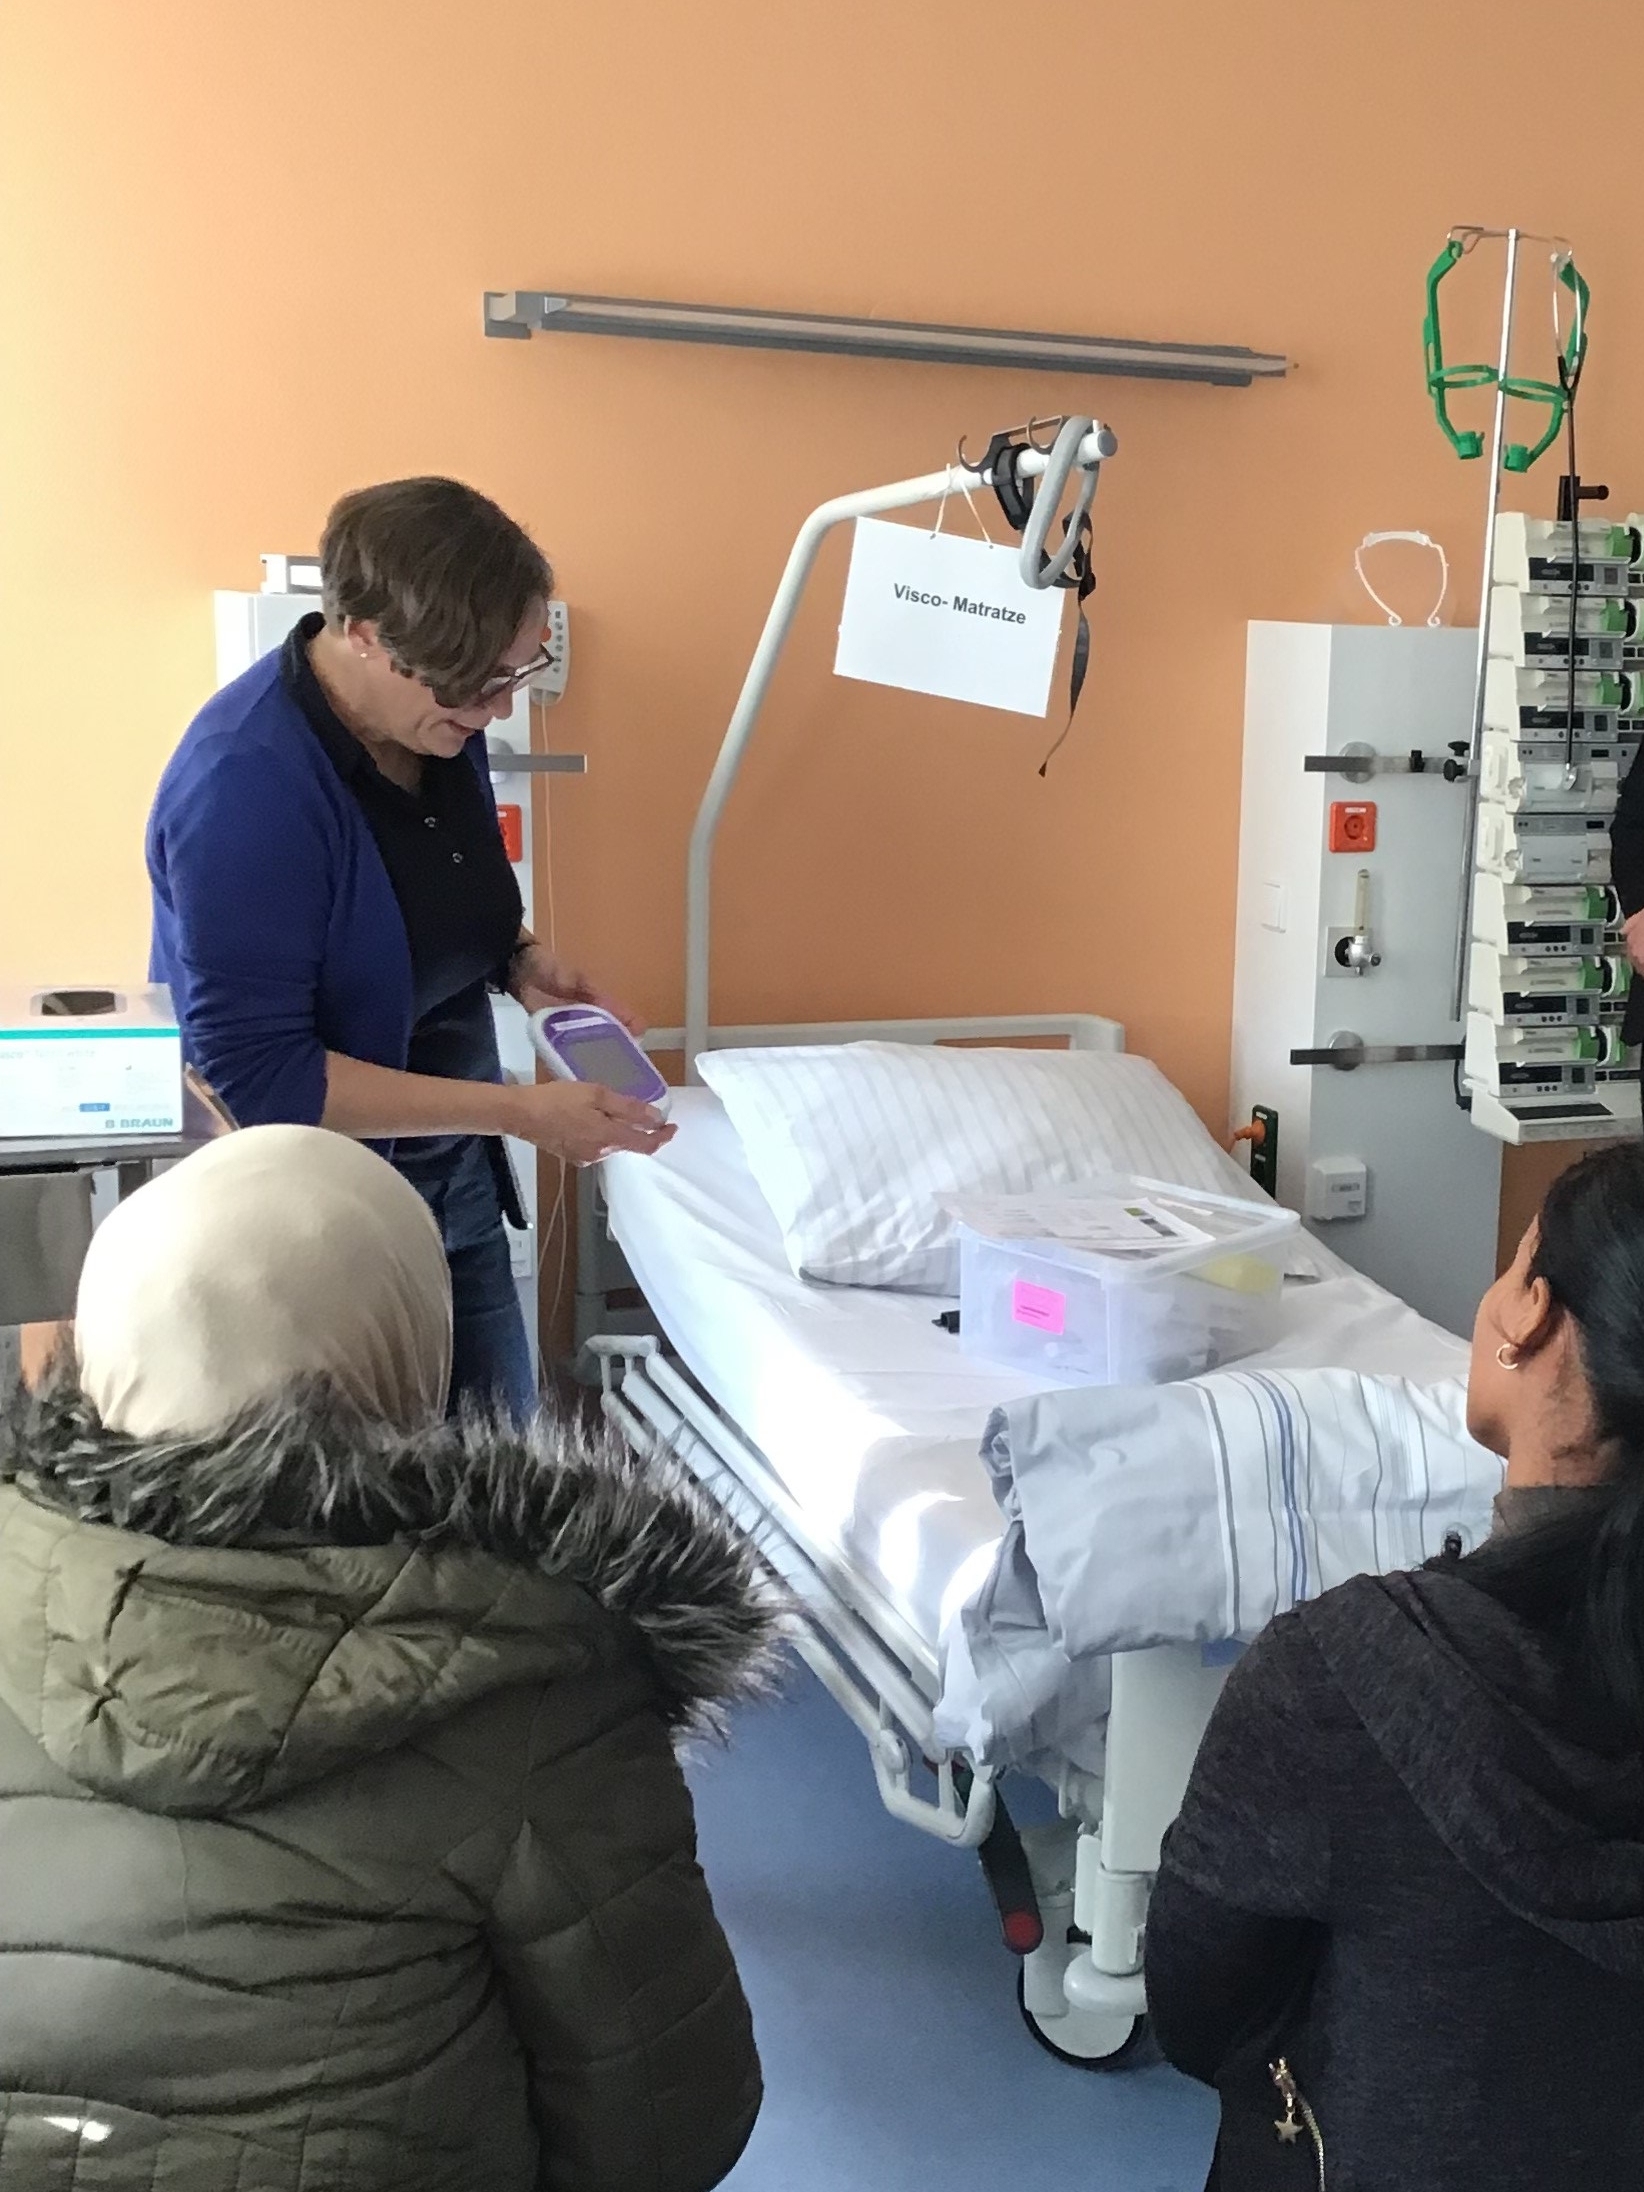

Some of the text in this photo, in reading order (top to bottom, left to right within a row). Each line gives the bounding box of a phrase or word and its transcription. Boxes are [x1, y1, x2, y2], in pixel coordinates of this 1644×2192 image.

[894, 583, 1026, 624] Visco- Matratze
[120, 1118, 173, 1128] BRAUN
